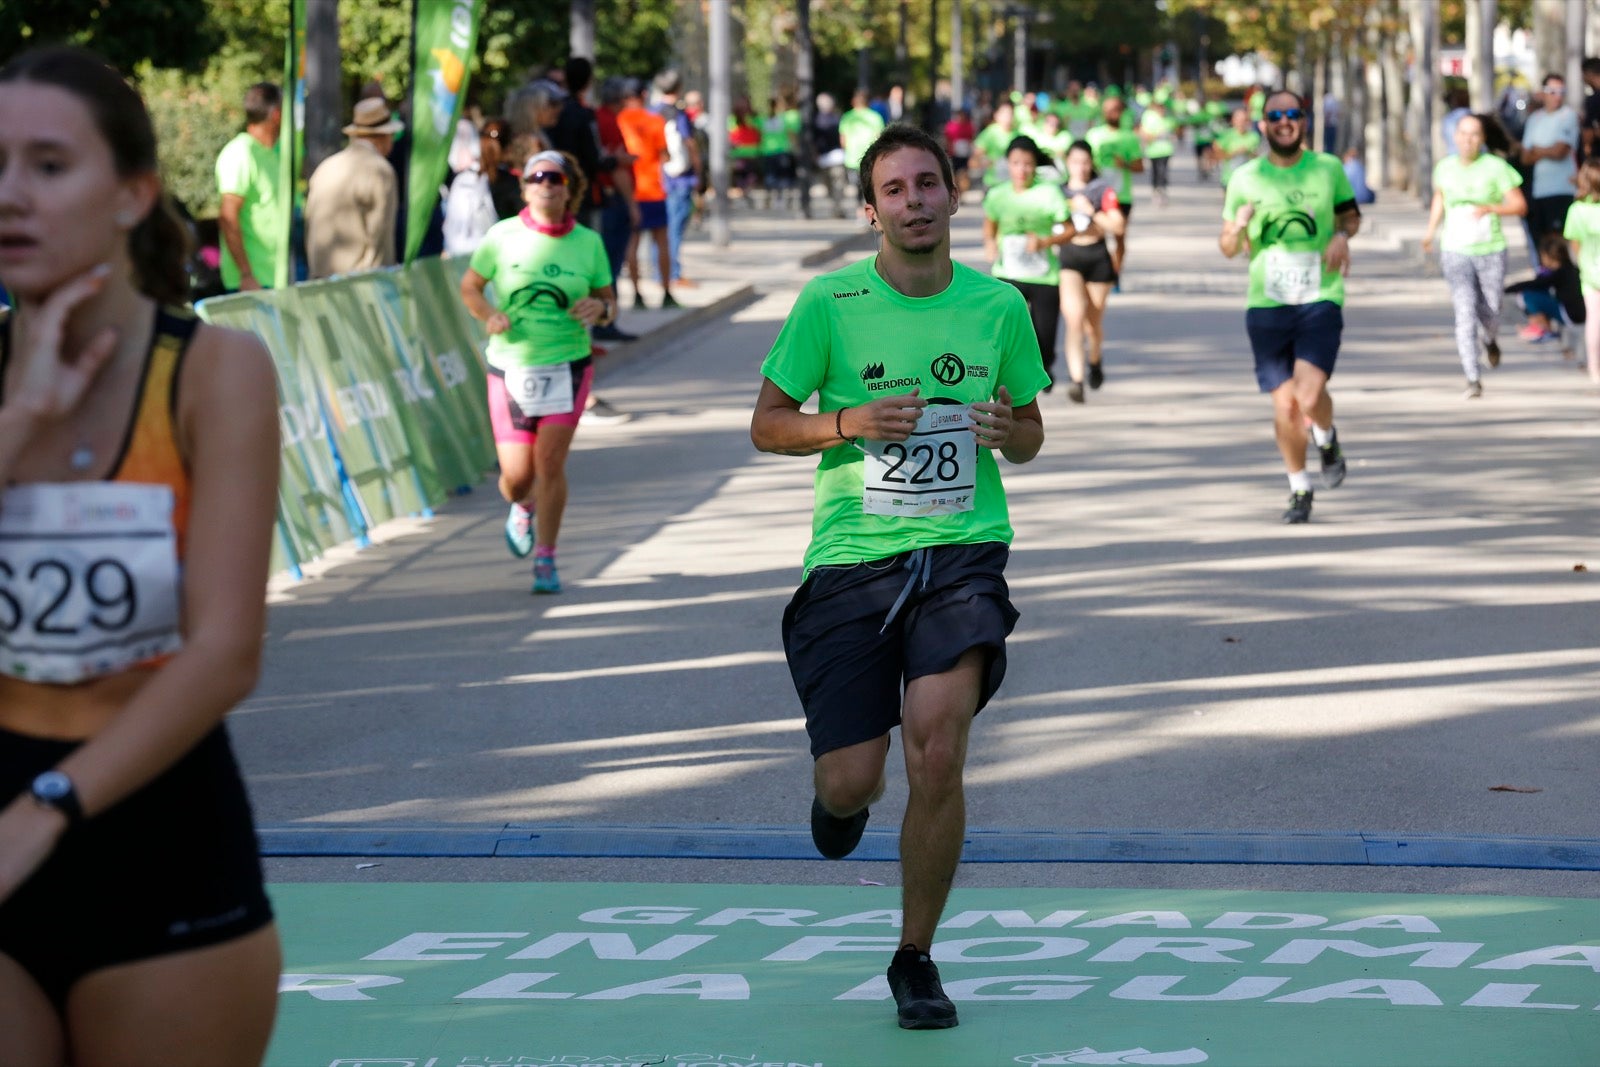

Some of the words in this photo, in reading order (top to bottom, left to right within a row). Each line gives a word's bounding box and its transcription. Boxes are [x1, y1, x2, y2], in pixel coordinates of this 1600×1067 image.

[833, 290, 860, 299] luanvi
[867, 377, 922, 391] IBERDROLA
[967, 370, 989, 378] MUJER
[523, 375, 552, 399] 97
[882, 441, 960, 485] 228
[577, 906, 1442, 933] GRANADA
[359, 931, 720, 962] EN
[454, 972, 751, 1001] LA
